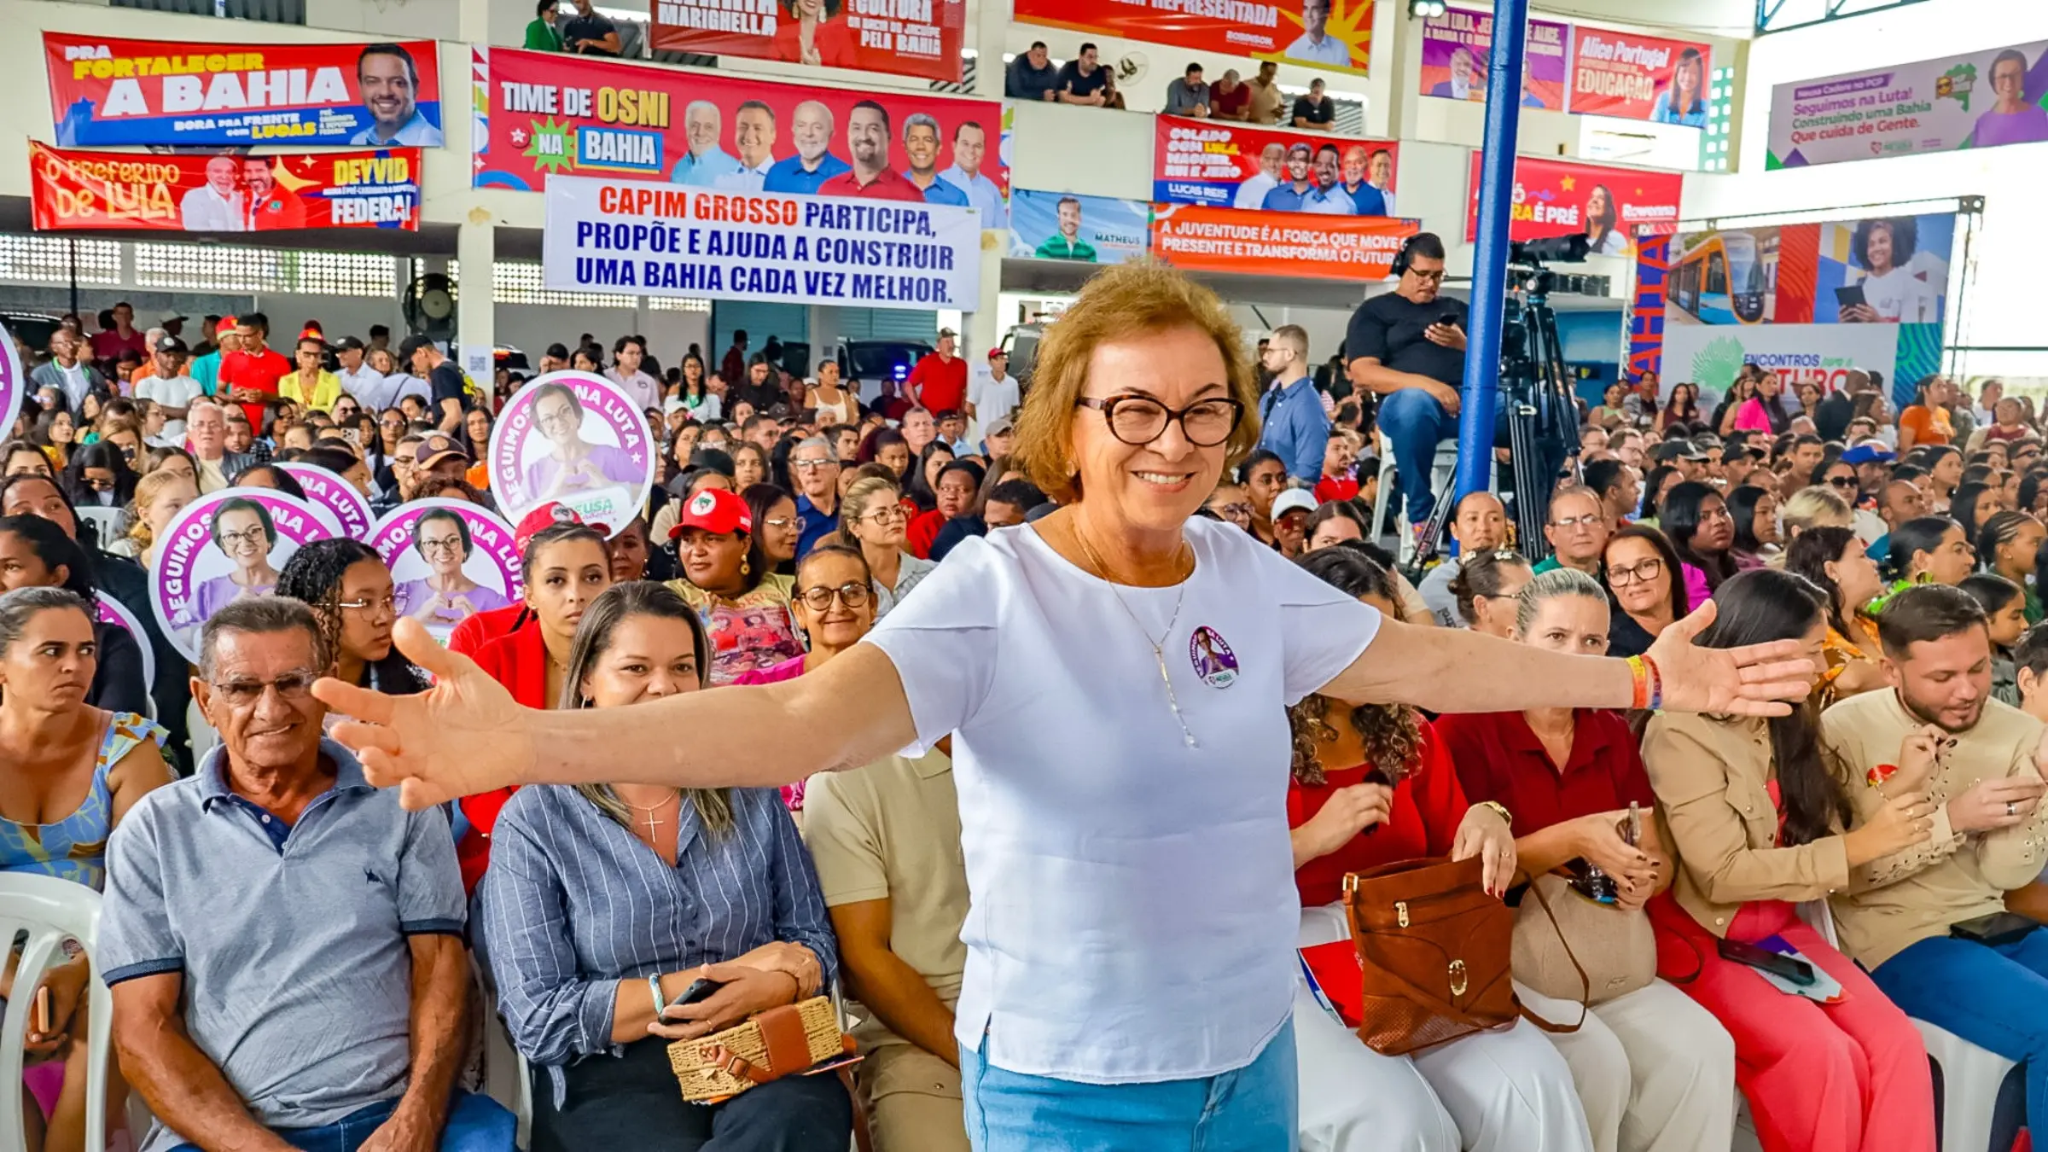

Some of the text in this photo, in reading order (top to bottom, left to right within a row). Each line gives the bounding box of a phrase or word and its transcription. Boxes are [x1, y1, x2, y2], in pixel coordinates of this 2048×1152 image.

[657, 3, 777, 36] MARIGHELLA
[65, 45, 112, 61] PRA
[861, 30, 941, 56] PELA BAHIA
[1580, 36, 1613, 60] Alice
[1613, 40, 1671, 71] Portugal
[73, 53, 264, 80] FORTALECER
[101, 66, 350, 117] A BAHIA
[1577, 68, 1655, 105] EDUCAÇÃO
[501, 82, 670, 130] TIME DE OSNI
[1792, 100, 1932, 130] Construindo uma Bahia
[1793, 87, 1913, 117] Seguimos na Luta!
[174, 119, 216, 132] BORA
[251, 121, 317, 140] LUCAS
[1791, 116, 1920, 145] Que cuida de Gente.
[538, 132, 564, 156] NA
[585, 130, 658, 166] BAHIA
[46, 157, 62, 181] O
[334, 157, 408, 186] DEYVID
[106, 181, 177, 220] LULA
[1168, 182, 1203, 196] LUCAS
[600, 186, 937, 239] CAPIM GROSSO PARTICIPA,
[1546, 205, 1580, 226] PRÉ
[577, 220, 954, 271] PROPÕE E AJUDA A CONSTRUIR
[1095, 234, 1140, 245] MATHEUS
[1161, 220, 1172, 234] A
[1175, 221, 1260, 241] JUVENTUDE
[1261, 224, 1271, 241] É
[1270, 228, 1282, 242] A
[1282, 229, 1328, 248] FORÇA
[1329, 232, 1358, 249] QUE
[1360, 234, 1399, 250] MOVE
[1162, 236, 1396, 266] PRESENTE E TRANSFORMA O FUTUR
[576, 256, 954, 303] UMA BAHIA CADA VEZ MELHOR.
[1743, 353, 1820, 367] ENCONTROS
[1770, 368, 1850, 398] TURO
[502, 384, 640, 508] SEGUIMOS NA LUTA
[299, 475, 327, 496] NA
[329, 490, 365, 539] LUTA
[574, 498, 614, 517] EUSA
[165, 505, 304, 625] SEGUIMOS NA
[468, 519, 525, 600] NA LUTA
